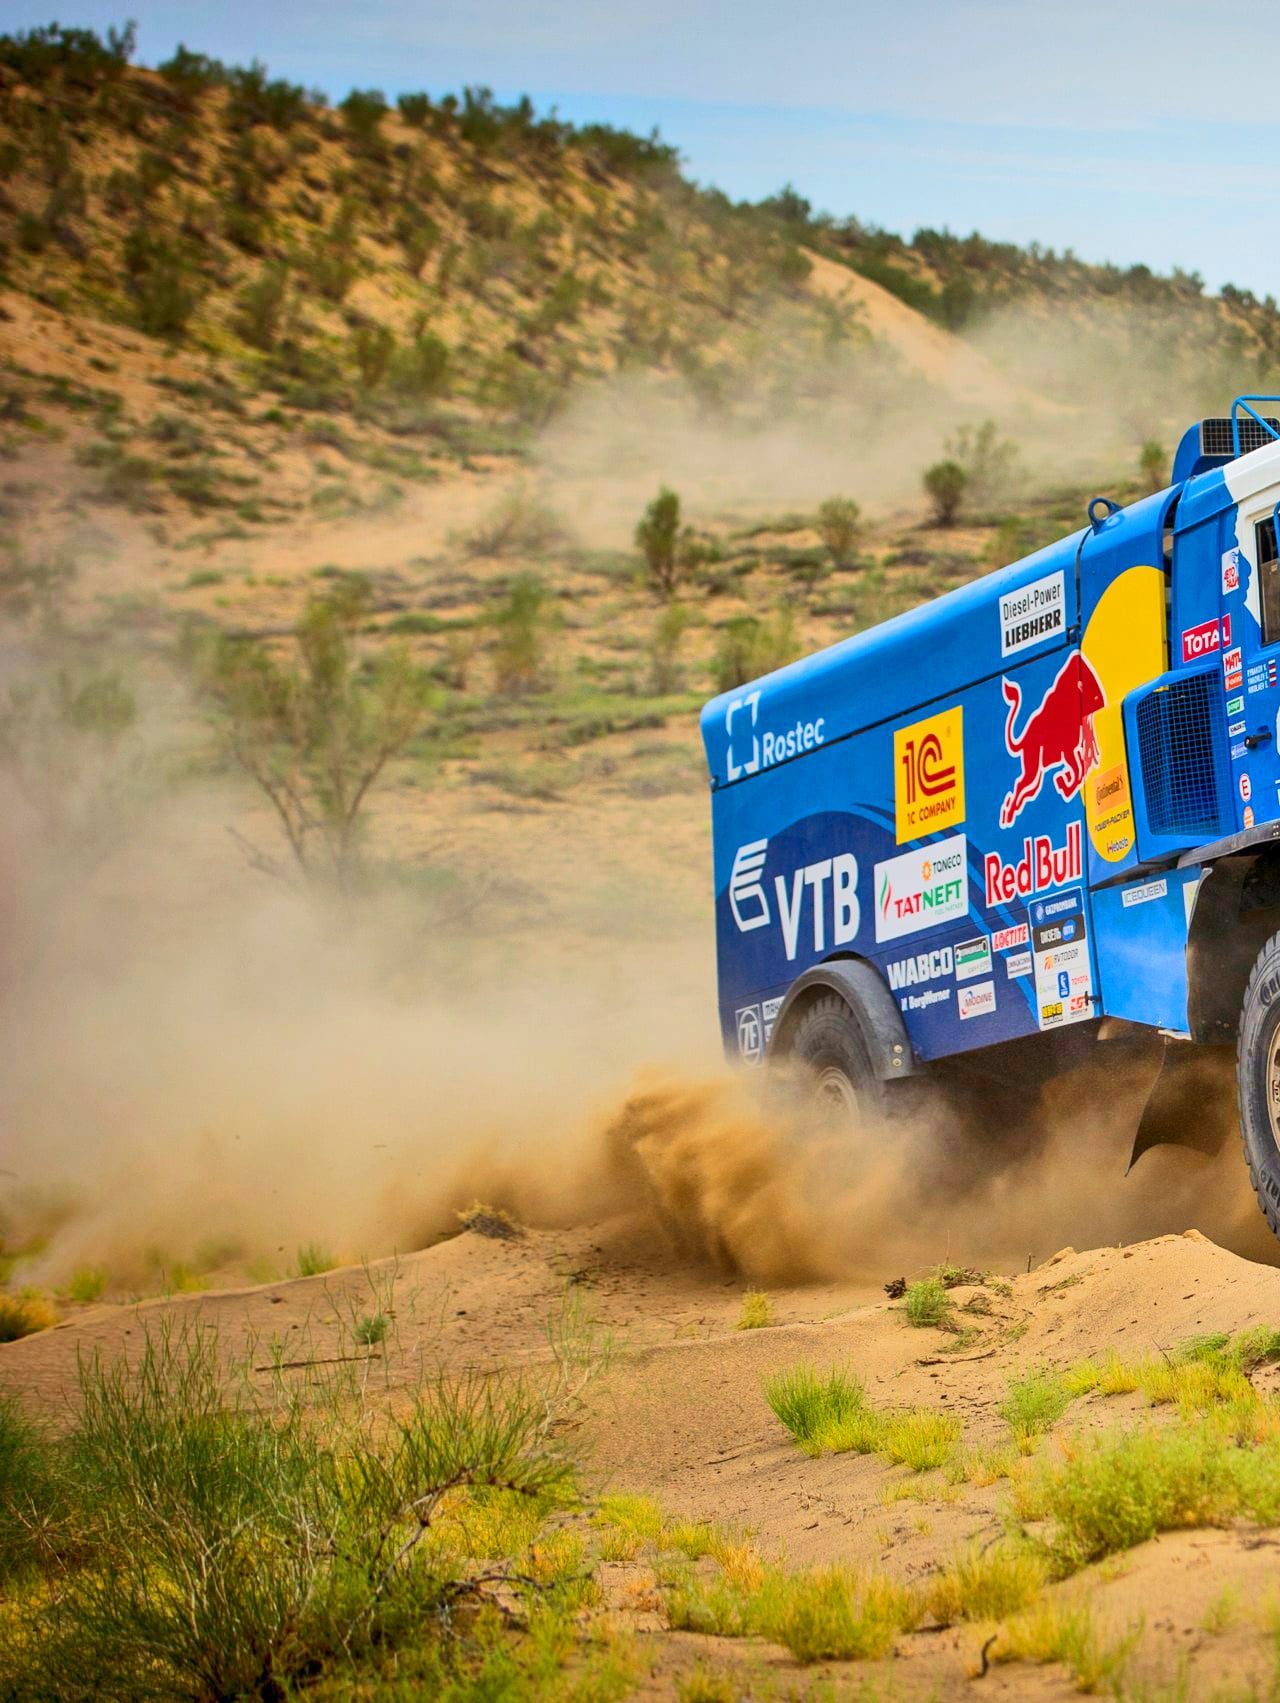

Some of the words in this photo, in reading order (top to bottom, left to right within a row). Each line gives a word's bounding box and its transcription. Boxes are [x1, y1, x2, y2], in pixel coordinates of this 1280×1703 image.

[1003, 584, 1060, 620] Diesel-Power
[1005, 608, 1061, 648] LIEBHERR
[1184, 626, 1230, 656] TOTAL
[763, 718, 824, 767] Rostec
[919, 797, 956, 821] COMPANY
[932, 854, 962, 873] TONECO
[986, 840, 1032, 905] Red
[1035, 823, 1081, 890] Bull
[774, 853, 861, 961] VTB
[894, 879, 962, 919] TATNEFT
[994, 926, 1027, 950] LOCTITE
[887, 946, 953, 991] WABCO
